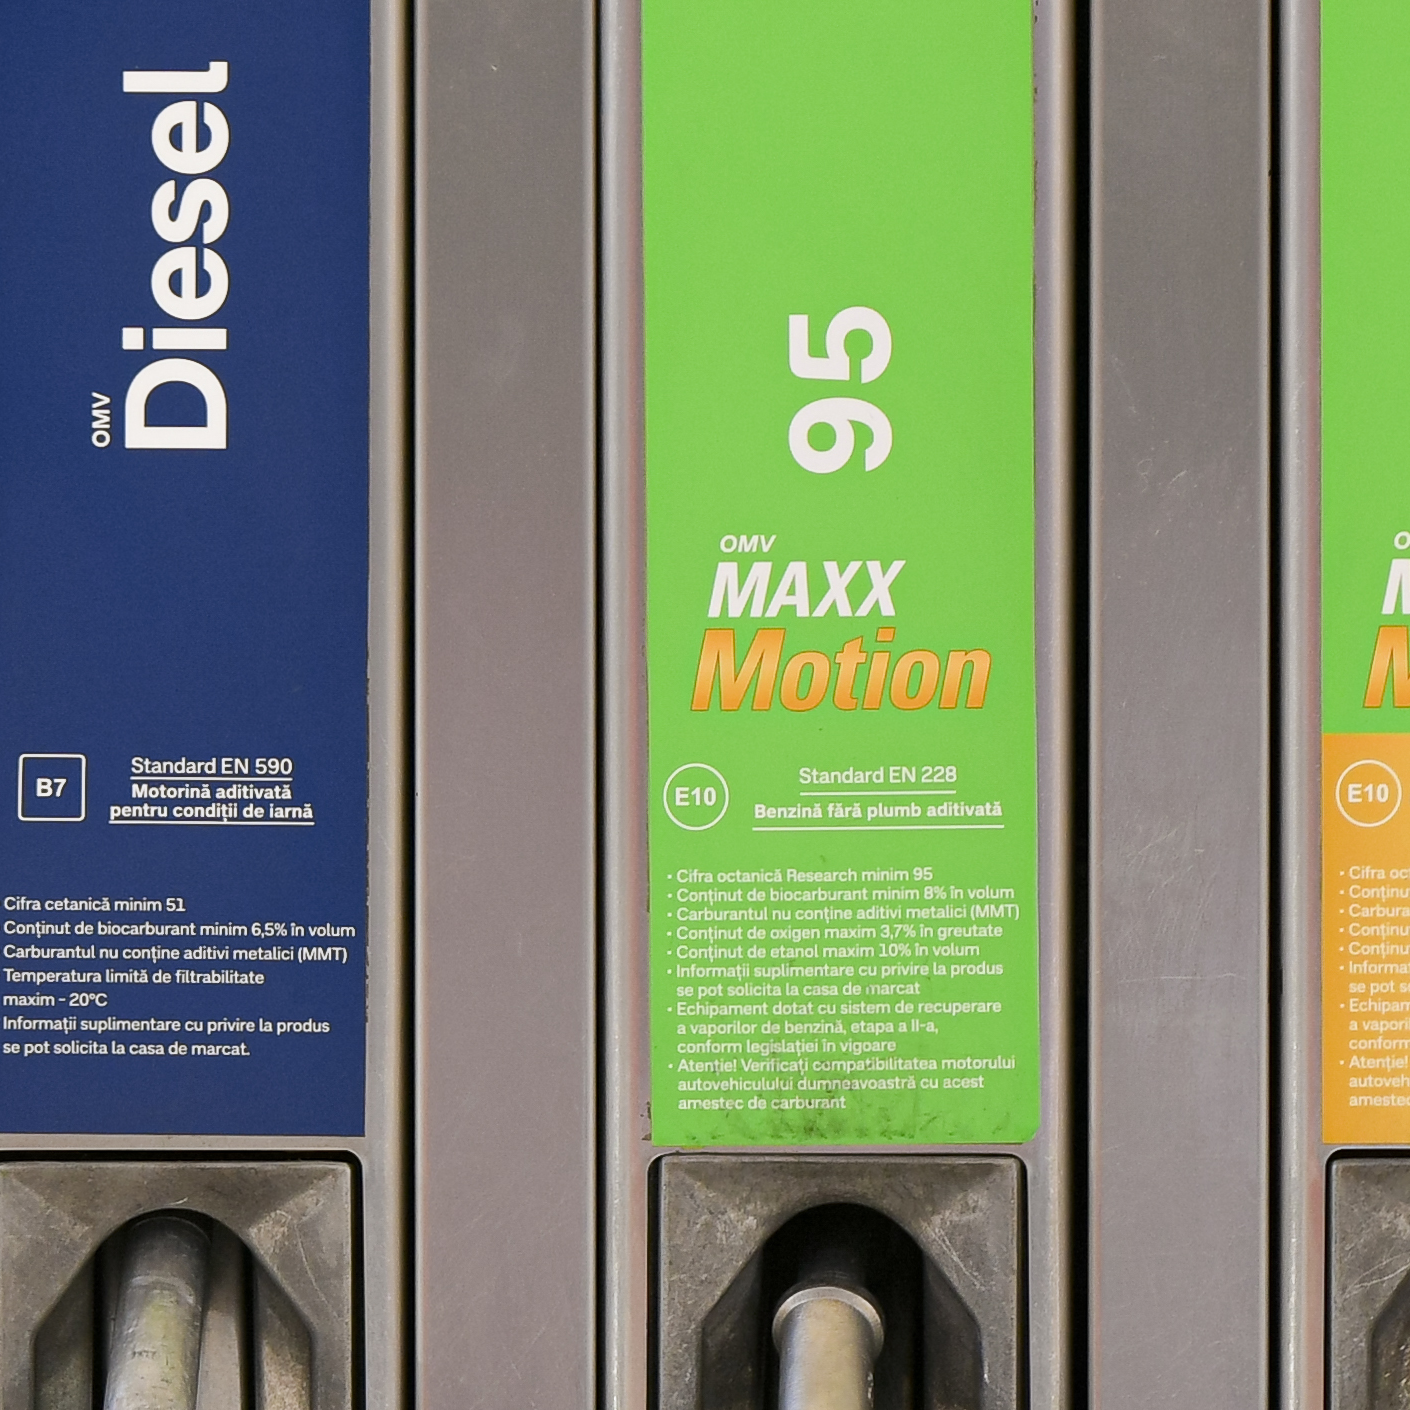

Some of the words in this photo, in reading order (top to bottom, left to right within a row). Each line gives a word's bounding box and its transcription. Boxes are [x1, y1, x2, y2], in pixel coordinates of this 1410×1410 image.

[122, 60, 230, 449] Diesel
[788, 306, 893, 474] 95
[92, 392, 111, 448] OMV
[719, 534, 777, 553] OMV
[707, 560, 906, 618] MAXX
[690, 626, 992, 712] Motion
[131, 757, 217, 775] Standard
[221, 758, 249, 775] EN
[255, 758, 293, 775] 590
[799, 766, 885, 785] Standard
[889, 766, 917, 784] EN
[921, 766, 958, 784] 228
[35, 778, 67, 798] B7
[132, 783, 212, 799] Motorină
[215, 784, 293, 800] aditivată
[675, 787, 717, 807] E10
[1347, 784, 1390, 803] E10
[110, 803, 168, 821] pentru
[242, 803, 265, 819] de
[270, 803, 314, 819] iarnă
[754, 803, 823, 819] Benzină
[827, 803, 863, 819] fără
[867, 802, 922, 822] plumb
[927, 801, 1003, 818] aditivată
[676, 869, 714, 884] Cifra
[717, 868, 783, 883] octanică
[787, 868, 858, 883] Research
[862, 867, 910, 882] minim
[913, 866, 934, 882] 95
[1349, 866, 1387, 880] Cifra
[4, 896, 42, 911] Cifra
[45, 897, 111, 912] cetanică
[114, 897, 163, 912] minim
[166, 898, 187, 912] 51
[74, 921, 95, 936] de
[98, 921, 197, 936] biocarburant
[200, 922, 248, 937] minim
[251, 922, 288, 939] 6,5%
[290, 922, 305, 937] în
[308, 922, 356, 937] volum
[3, 944, 96, 959] Carburantul
[99, 948, 119, 960] nu
[183, 946, 230, 960] aditivi
[233, 946, 294, 961] metalici
[298, 947, 348, 964] (MMT)
[3, 968, 102, 986] Temperatura
[106, 968, 149, 984] limită
[152, 969, 172, 984] de
[175, 969, 265, 985] filtrabilitate
[3, 992, 56, 1007] maxim
[676, 986, 694, 998] se
[698, 983, 724, 1000] pot
[727, 982, 783, 997] solicita
[786, 982, 800, 997] la
[803, 985, 839, 997] casa
[842, 982, 862, 996] de
[866, 982, 921, 996] marcat
[80, 1016, 182, 1035] suplimentare
[185, 1020, 204, 1032] cu
[207, 1018, 256, 1035] privire
[259, 1018, 274, 1033] la
[277, 1018, 331, 1036] produs
[3, 1043, 21, 1054] se
[24, 1041, 51, 1057] pot
[53, 1040, 109, 1055] solicita
[112, 1040, 126, 1055] la
[129, 1044, 166, 1055] casa
[168, 1041, 188, 1056] de
[191, 1042, 251, 1056] marcat.
